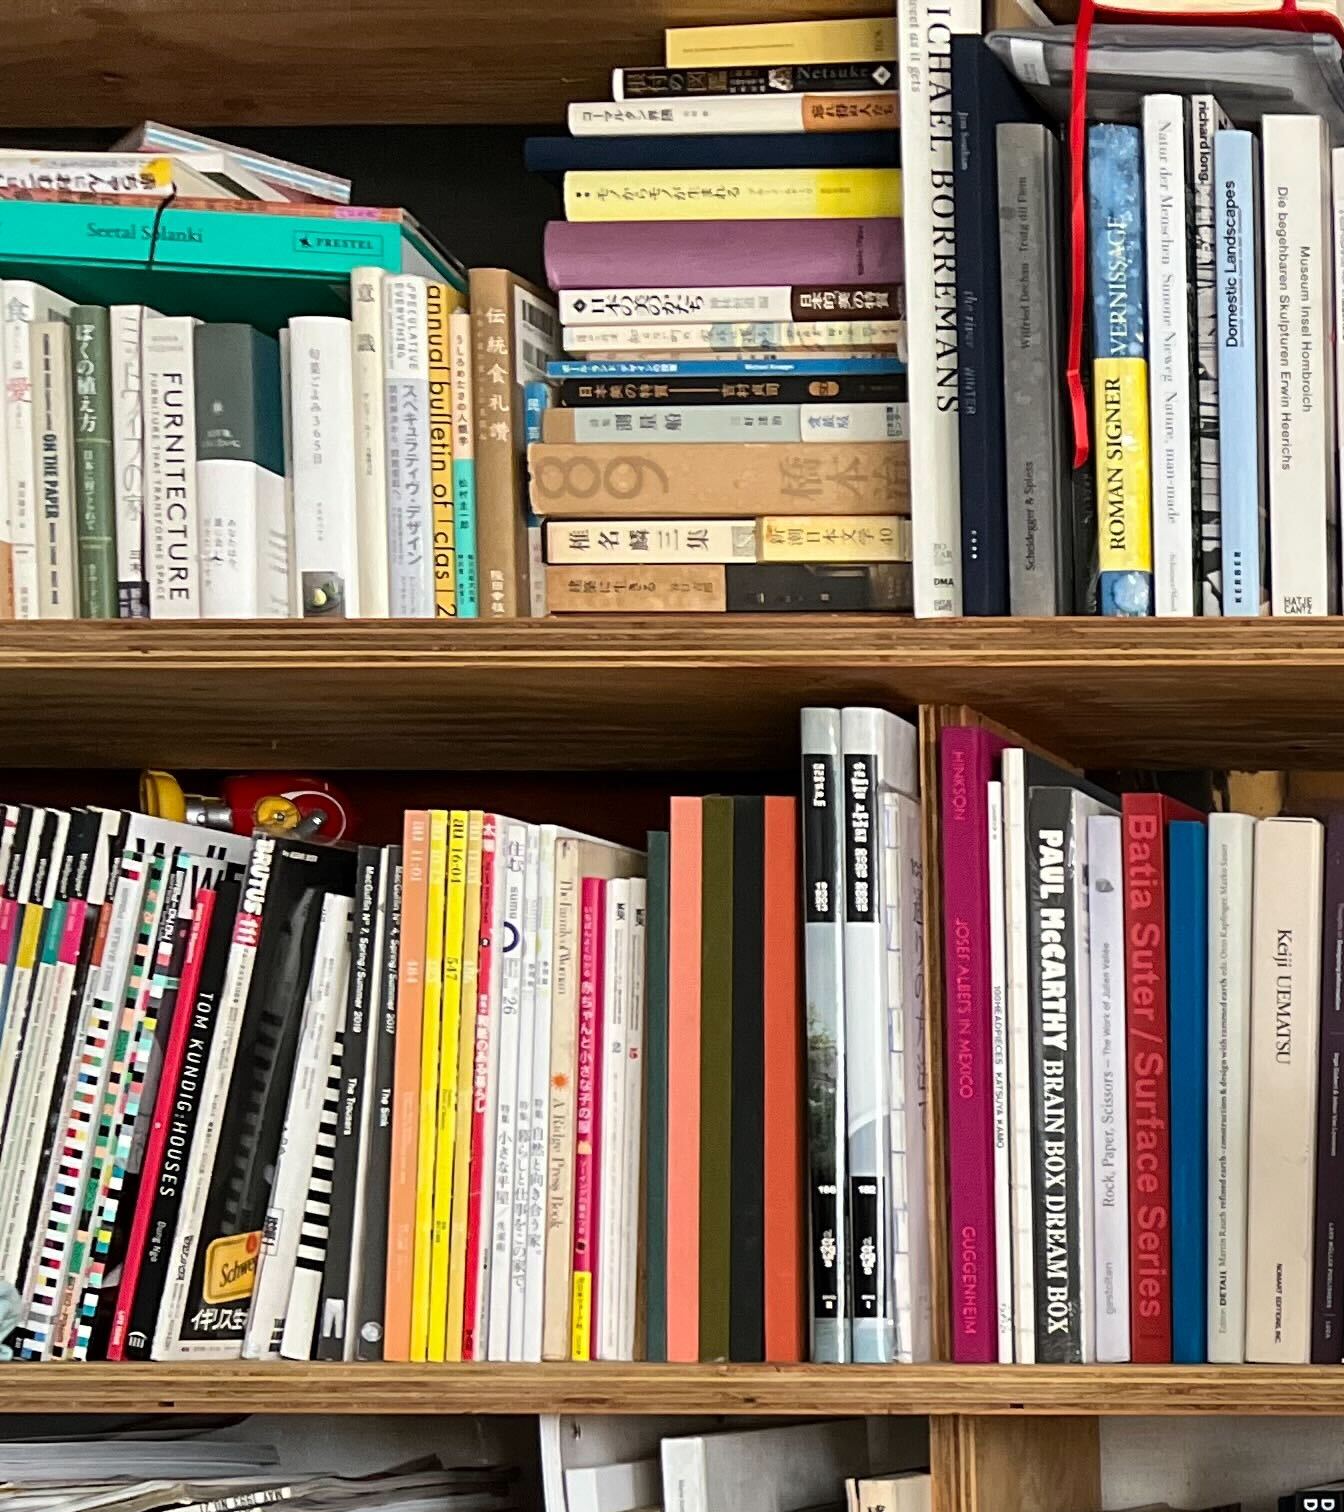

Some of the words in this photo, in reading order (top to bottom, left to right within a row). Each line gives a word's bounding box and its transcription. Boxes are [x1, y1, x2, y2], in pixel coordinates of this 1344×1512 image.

[926, 7, 953, 153] ICHAEL
[1223, 181, 1240, 272] Landscapes
[1277, 187, 1289, 204] Die
[316, 238, 374, 250] PRESTEL
[1277, 207, 1291, 289] begehbaren
[1300, 246, 1311, 298] Museum
[394, 283, 405, 358] EVERYTHING
[931, 170, 958, 413] BORREMANS
[1107, 216, 1129, 356] VERNISSAGE
[1225, 278, 1238, 347] Domestic
[1301, 302, 1312, 334] Insel
[405, 283, 419, 370] SPECULATIVE
[428, 284, 451, 370] annual
[1279, 295, 1293, 367] Skulpturen
[456, 334, 469, 446] うしろめたさの人類学
[1280, 372, 1292, 407] Erwin
[1301, 339, 1313, 412] Hombroich
[42, 433, 57, 451] ON
[429, 381, 452, 470] bulletin
[1105, 376, 1123, 460] SIGNER
[1281, 413, 1293, 471] Heerichs
[43, 454, 58, 475] THE
[44, 478, 60, 519] PAPER
[162, 373, 190, 601] FURNITECTURE
[433, 484, 454, 508] of
[1108, 468, 1127, 551] ROMAN
[934, 578, 954, 586] DMA
[244, 839, 275, 916] BRUTUS
[363, 866, 375, 911] MacGuffin
[1039, 830, 1064, 899] PAUL
[1128, 815, 1157, 909] Batia
[355, 938, 370, 1009] Spring/Summer
[1039, 908, 1068, 1051] McCARTHY
[1128, 923, 1160, 1020] Suter
[1276, 929, 1293, 969] Keiji
[189, 991, 215, 1034] TOM
[353, 1011, 363, 1033] 2019
[1276, 976, 1293, 1066] UEMATSU
[379, 1106, 391, 1127] Sink
[382, 1088, 392, 1104] The
[1043, 1060, 1066, 1133] BRAIN
[1134, 1052, 1165, 1194] Surface
[1045, 1141, 1066, 1188] BOX
[1046, 1194, 1068, 1280] DREAM
[1137, 1206, 1167, 1318] Series
[961, 1225, 978, 1335] GUGGENHEIM
[1047, 1286, 1070, 1334] BOX
